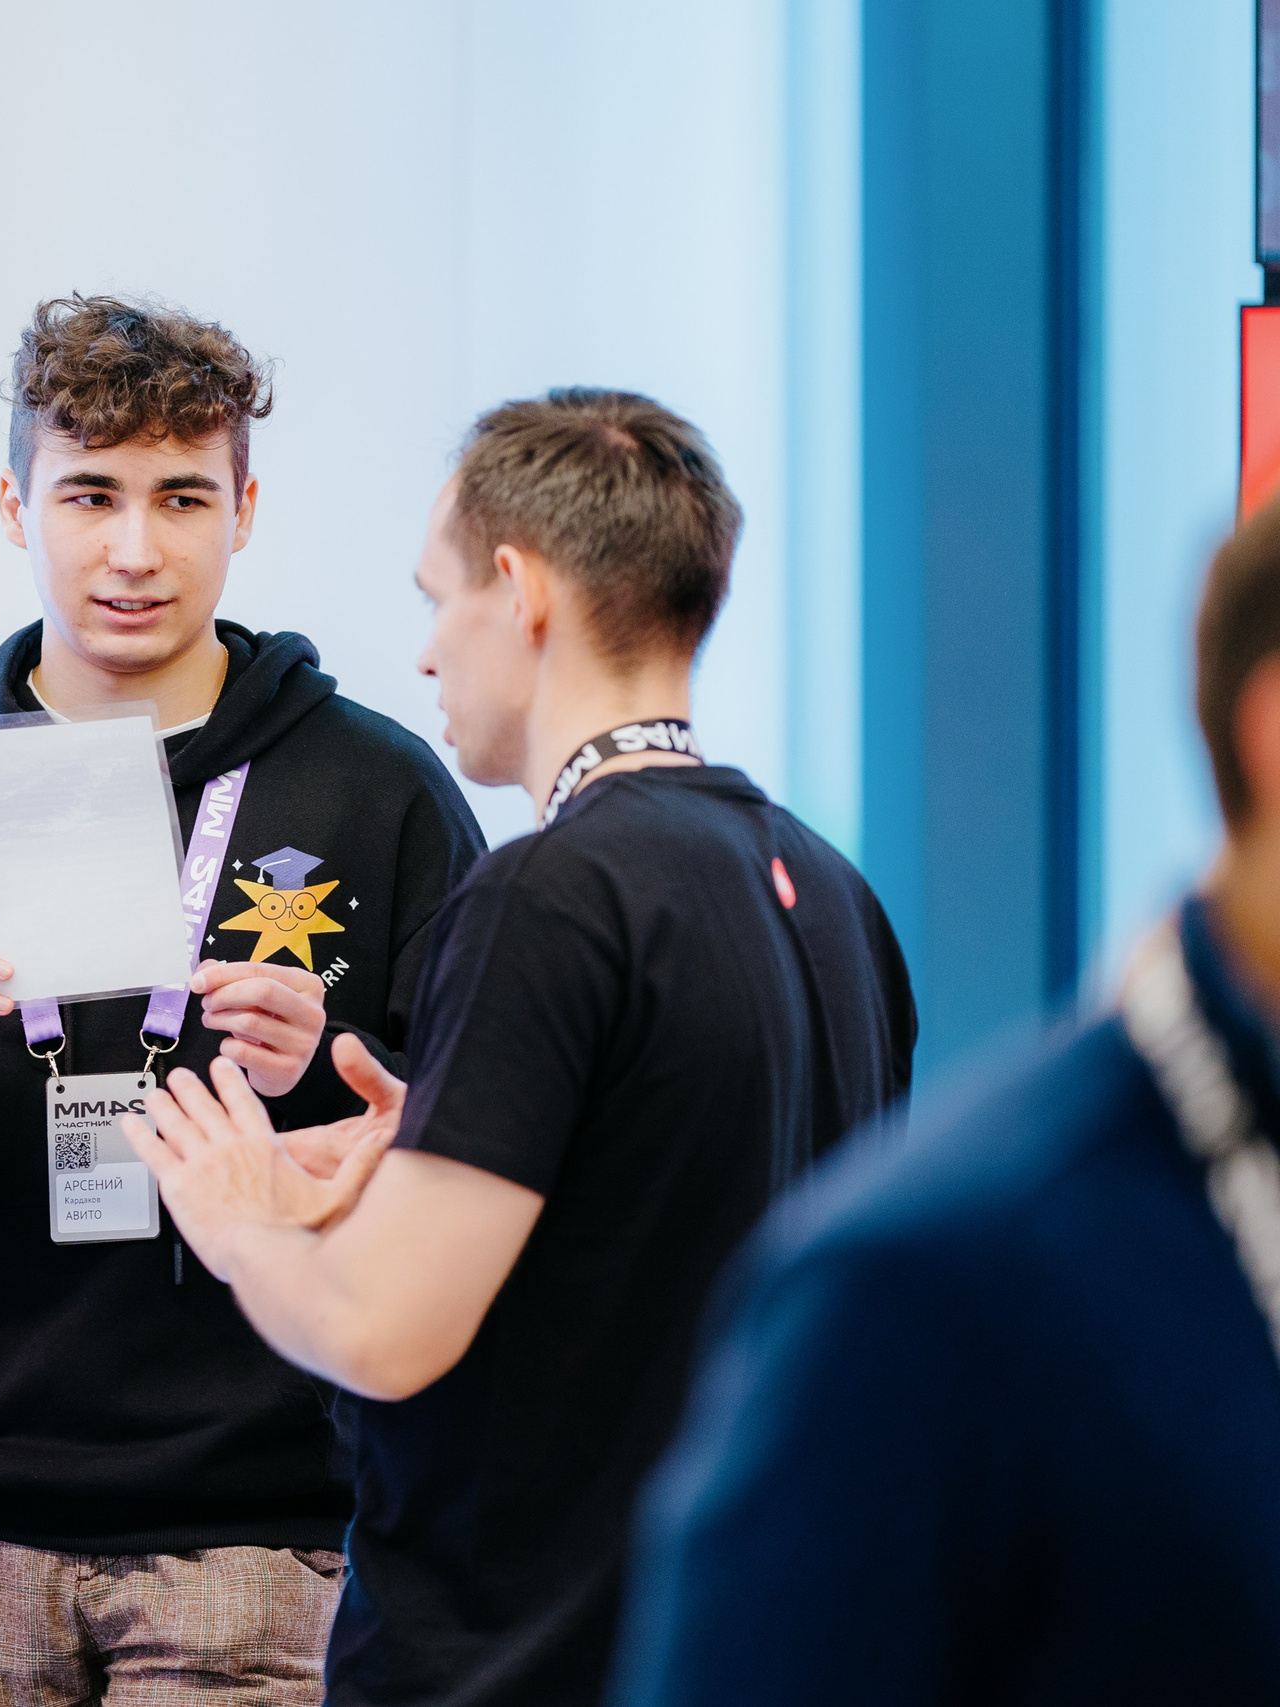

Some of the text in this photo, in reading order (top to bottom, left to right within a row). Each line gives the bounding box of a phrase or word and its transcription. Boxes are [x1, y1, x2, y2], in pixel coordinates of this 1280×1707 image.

[321, 956, 350, 992] RN
[55, 1120, 113, 1129] УЧАСТНИК
[64, 1176, 123, 1191] АРСЕНИЙ
[64, 1196, 101, 1206] Кардаков
[65, 1209, 102, 1221] АВИТО
